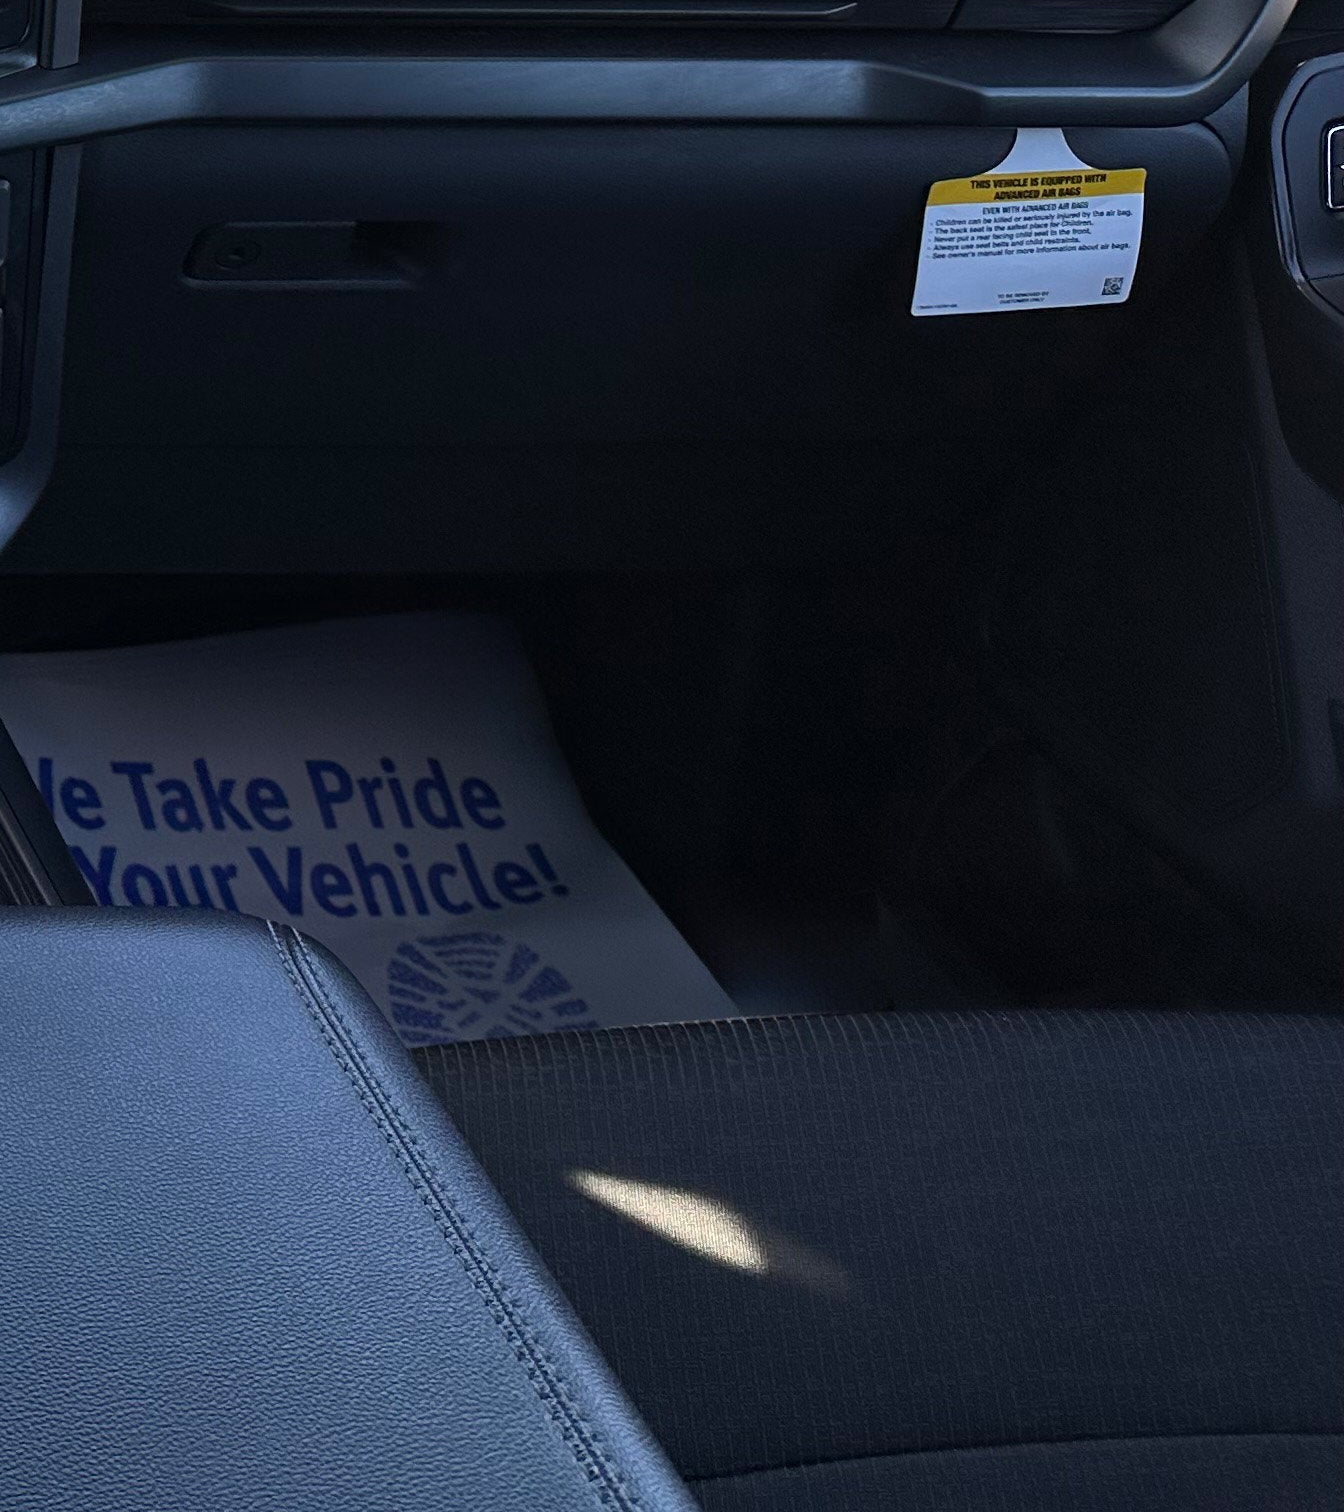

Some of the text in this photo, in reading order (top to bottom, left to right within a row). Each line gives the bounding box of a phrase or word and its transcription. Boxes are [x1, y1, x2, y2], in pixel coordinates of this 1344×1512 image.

[970, 179, 991, 190] THIS
[992, 178, 1028, 189] VEHICLE
[1030, 177, 1039, 187] IS
[1084, 173, 1107, 184] WITH
[994, 189, 1041, 201] ADVANCED
[1041, 188, 1056, 198] AIR
[110, 758, 291, 833] Take
[306, 758, 505, 832] Pride
[70, 842, 569, 919] Your Vehicle!
